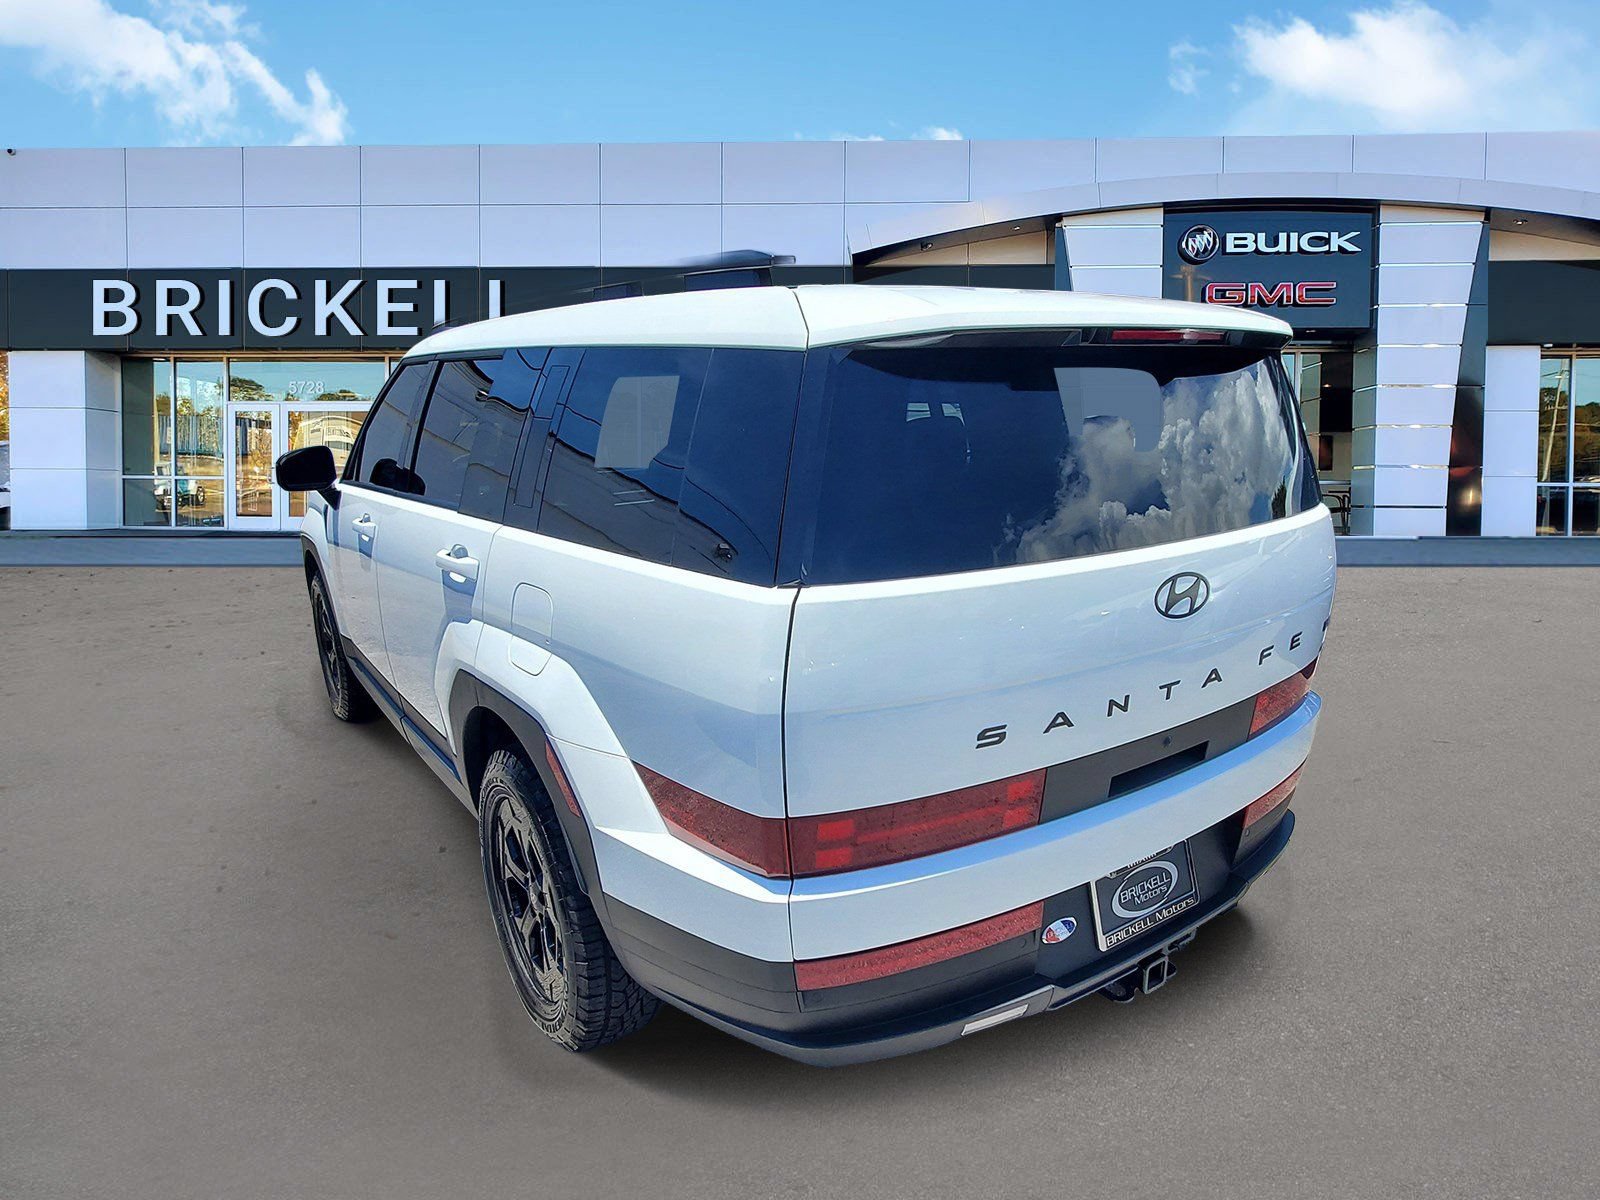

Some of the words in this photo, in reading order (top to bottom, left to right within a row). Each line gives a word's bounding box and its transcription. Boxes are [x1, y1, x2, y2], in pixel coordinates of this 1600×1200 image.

[1226, 231, 1361, 253] BUICK
[1206, 282, 1337, 305] GMC
[288, 381, 325, 394] 5728
[975, 668, 1223, 749] SANTA
[1258, 631, 1303, 666] FE
[1119, 872, 1171, 903] BRICKELL
[1133, 884, 1167, 905] Motors
[1106, 917, 1154, 947] BRICKELL
[1155, 897, 1195, 923] Motors
